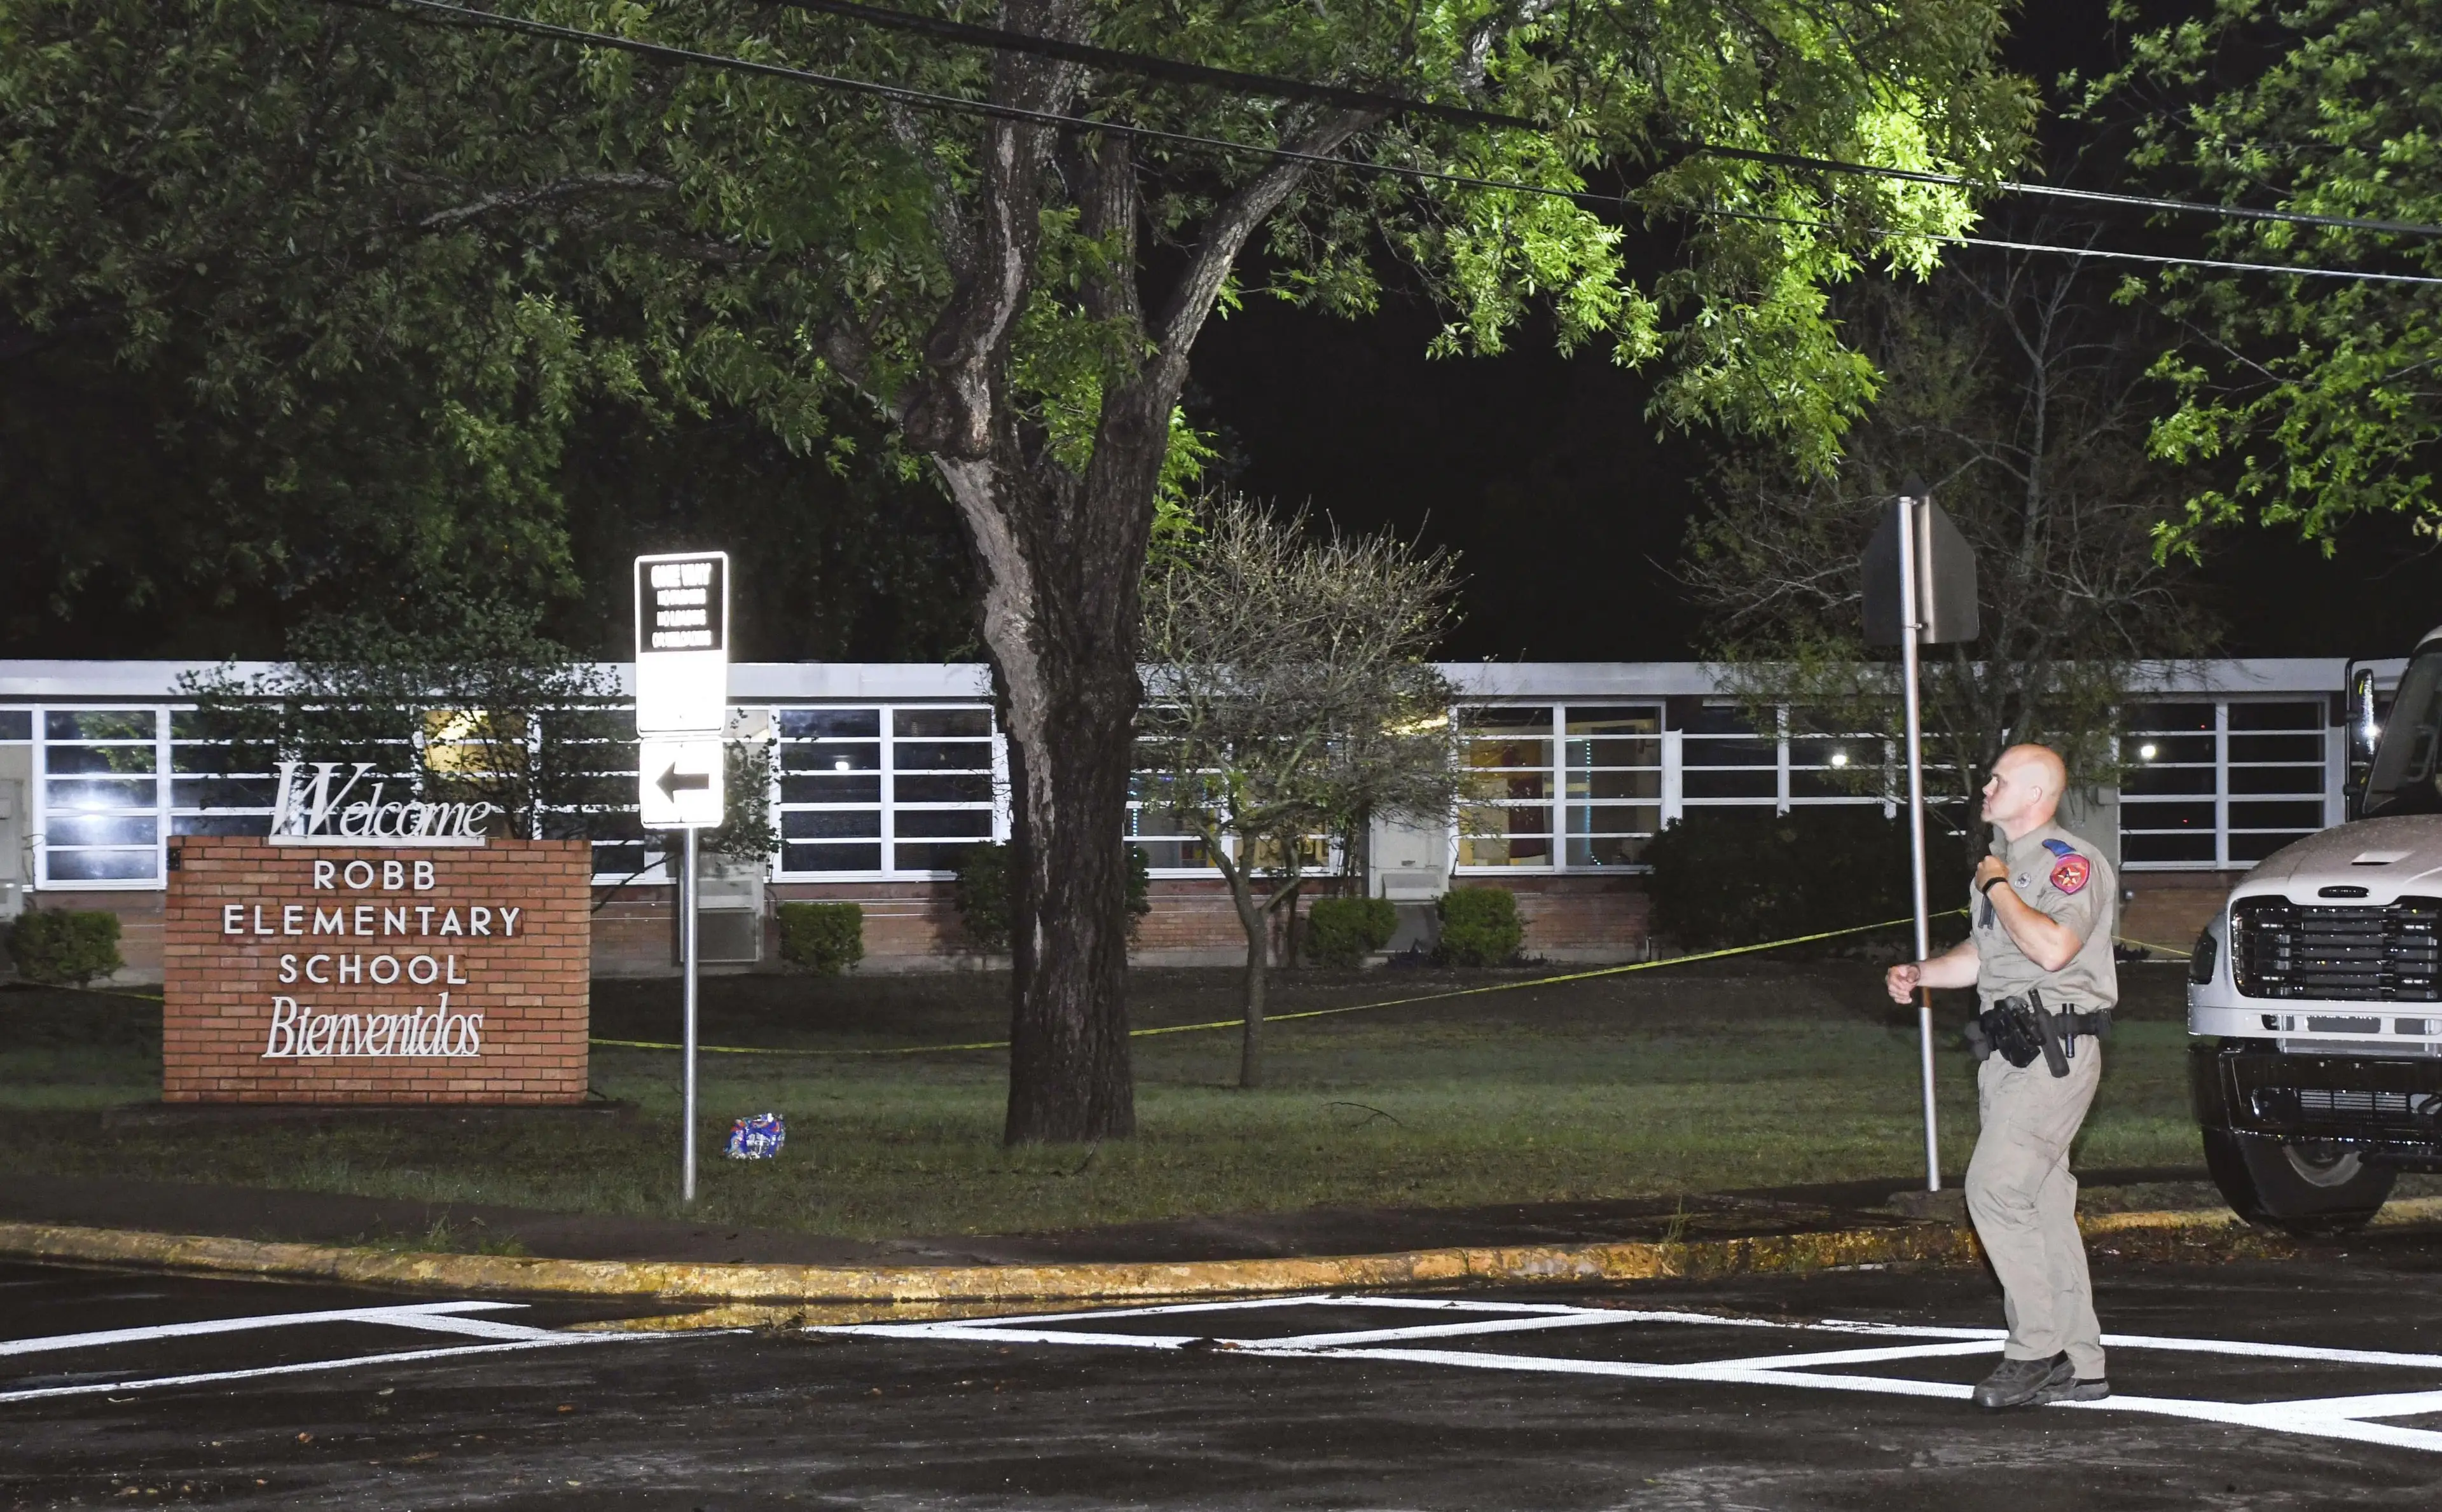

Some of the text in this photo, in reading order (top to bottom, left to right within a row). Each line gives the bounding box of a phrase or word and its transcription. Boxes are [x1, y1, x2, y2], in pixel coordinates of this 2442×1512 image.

[271, 761, 490, 839] Welcome
[314, 860, 436, 890] ROBB
[223, 904, 520, 937] ELEMENTARY
[278, 954, 467, 984] SCHOOL
[261, 991, 484, 1057] Bienvenidos
